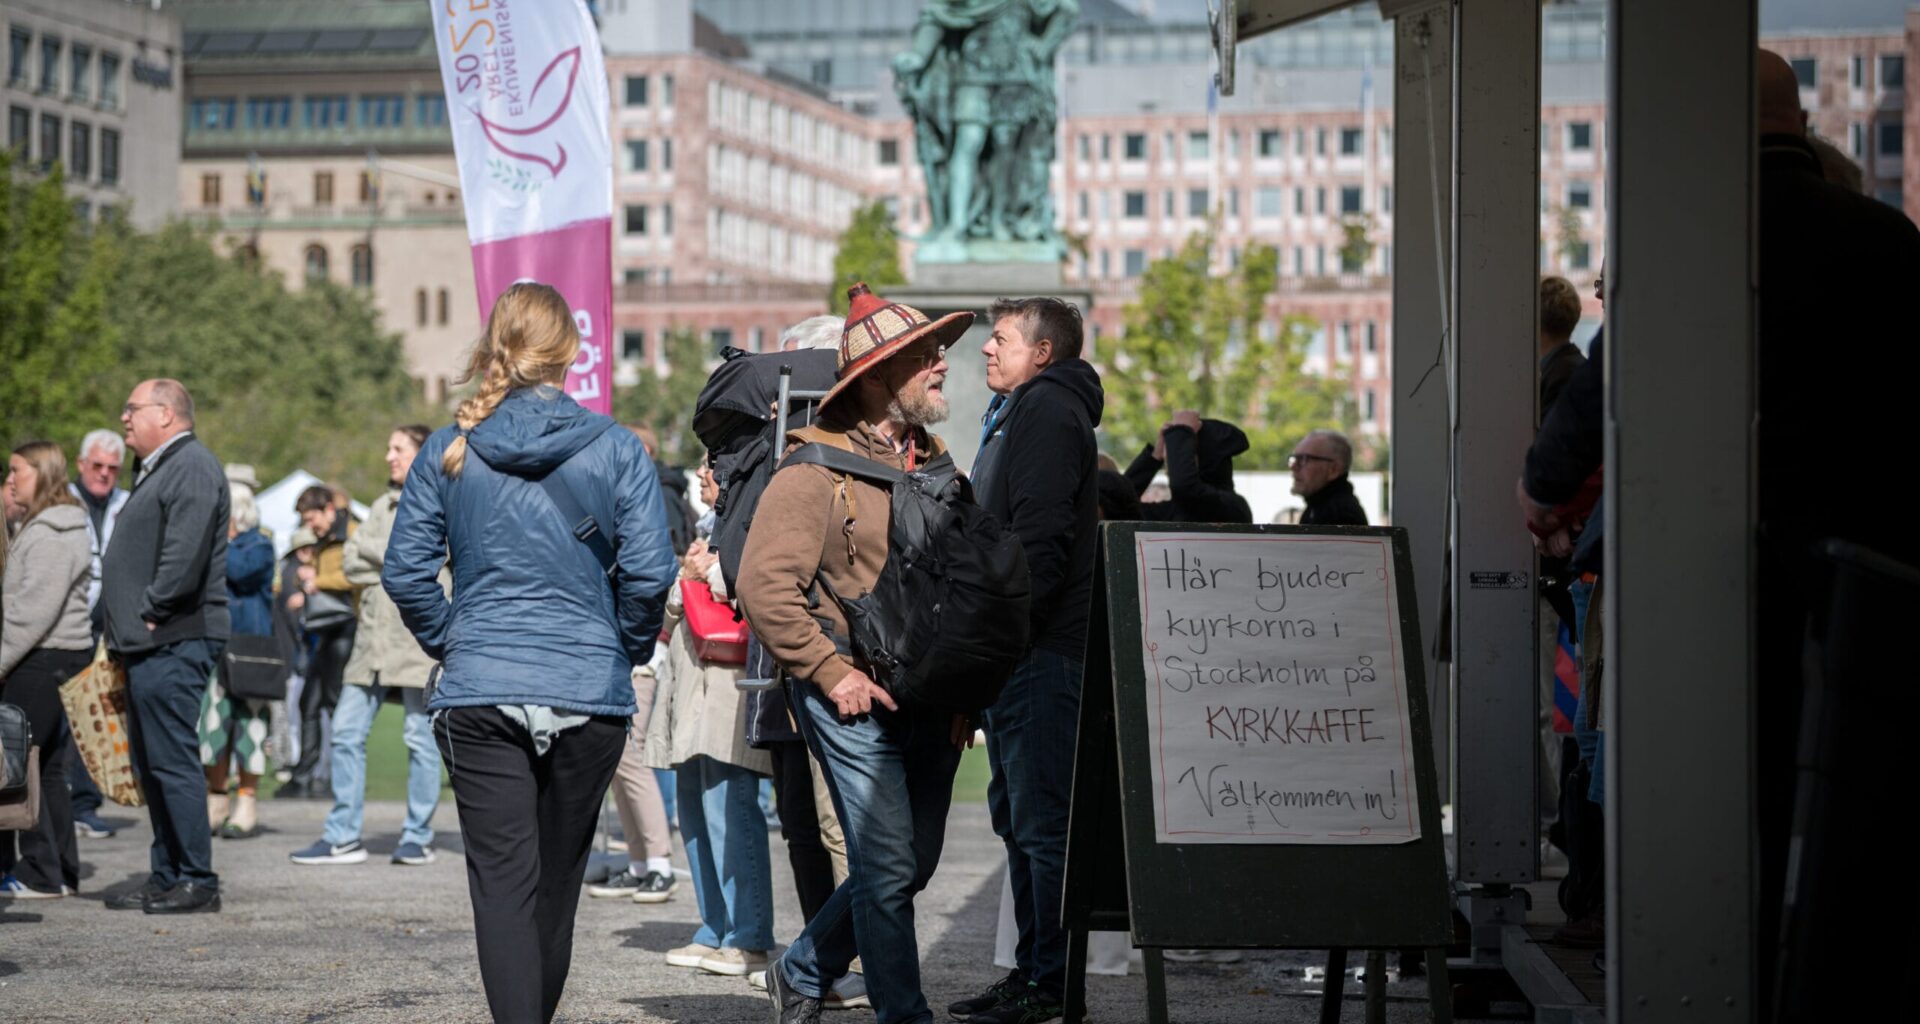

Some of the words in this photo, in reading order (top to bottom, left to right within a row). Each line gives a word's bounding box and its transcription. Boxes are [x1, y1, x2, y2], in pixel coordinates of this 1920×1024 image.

[1151, 548, 1233, 592] Här
[1256, 557, 1365, 613] bjuder
[1167, 609, 1316, 655] kyrkorna
[1332, 612, 1341, 638] i
[1165, 655, 1330, 693] Stockholm
[1344, 655, 1377, 697] på
[1206, 705, 1385, 744] KYRKKAFFE
[1178, 764, 1357, 829] Välkommen
[1361, 769, 1398, 821] in!
